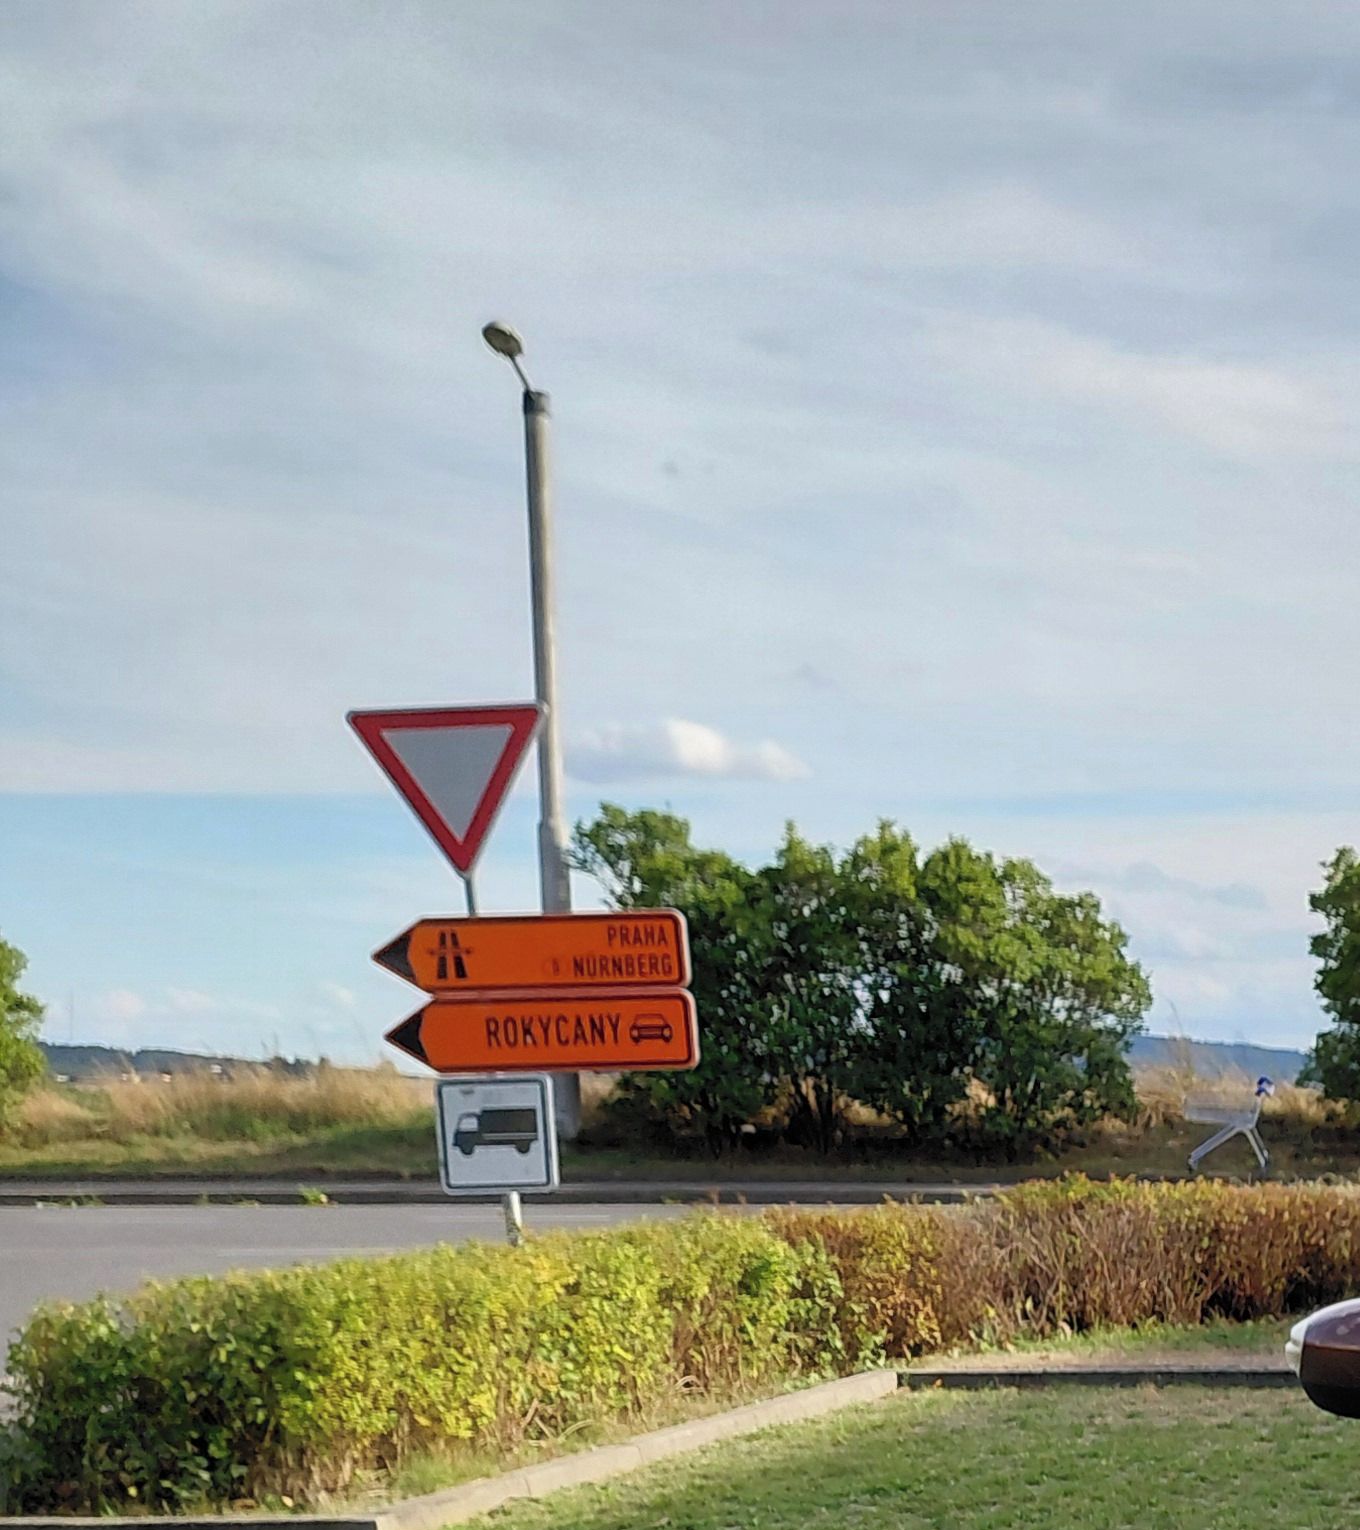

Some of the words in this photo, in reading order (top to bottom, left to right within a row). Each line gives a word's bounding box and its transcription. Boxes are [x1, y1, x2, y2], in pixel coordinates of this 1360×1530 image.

[607, 925, 669, 948] PRAHA
[572, 952, 673, 978] NÜRNBERG
[485, 1013, 621, 1049] ROKYCANY
